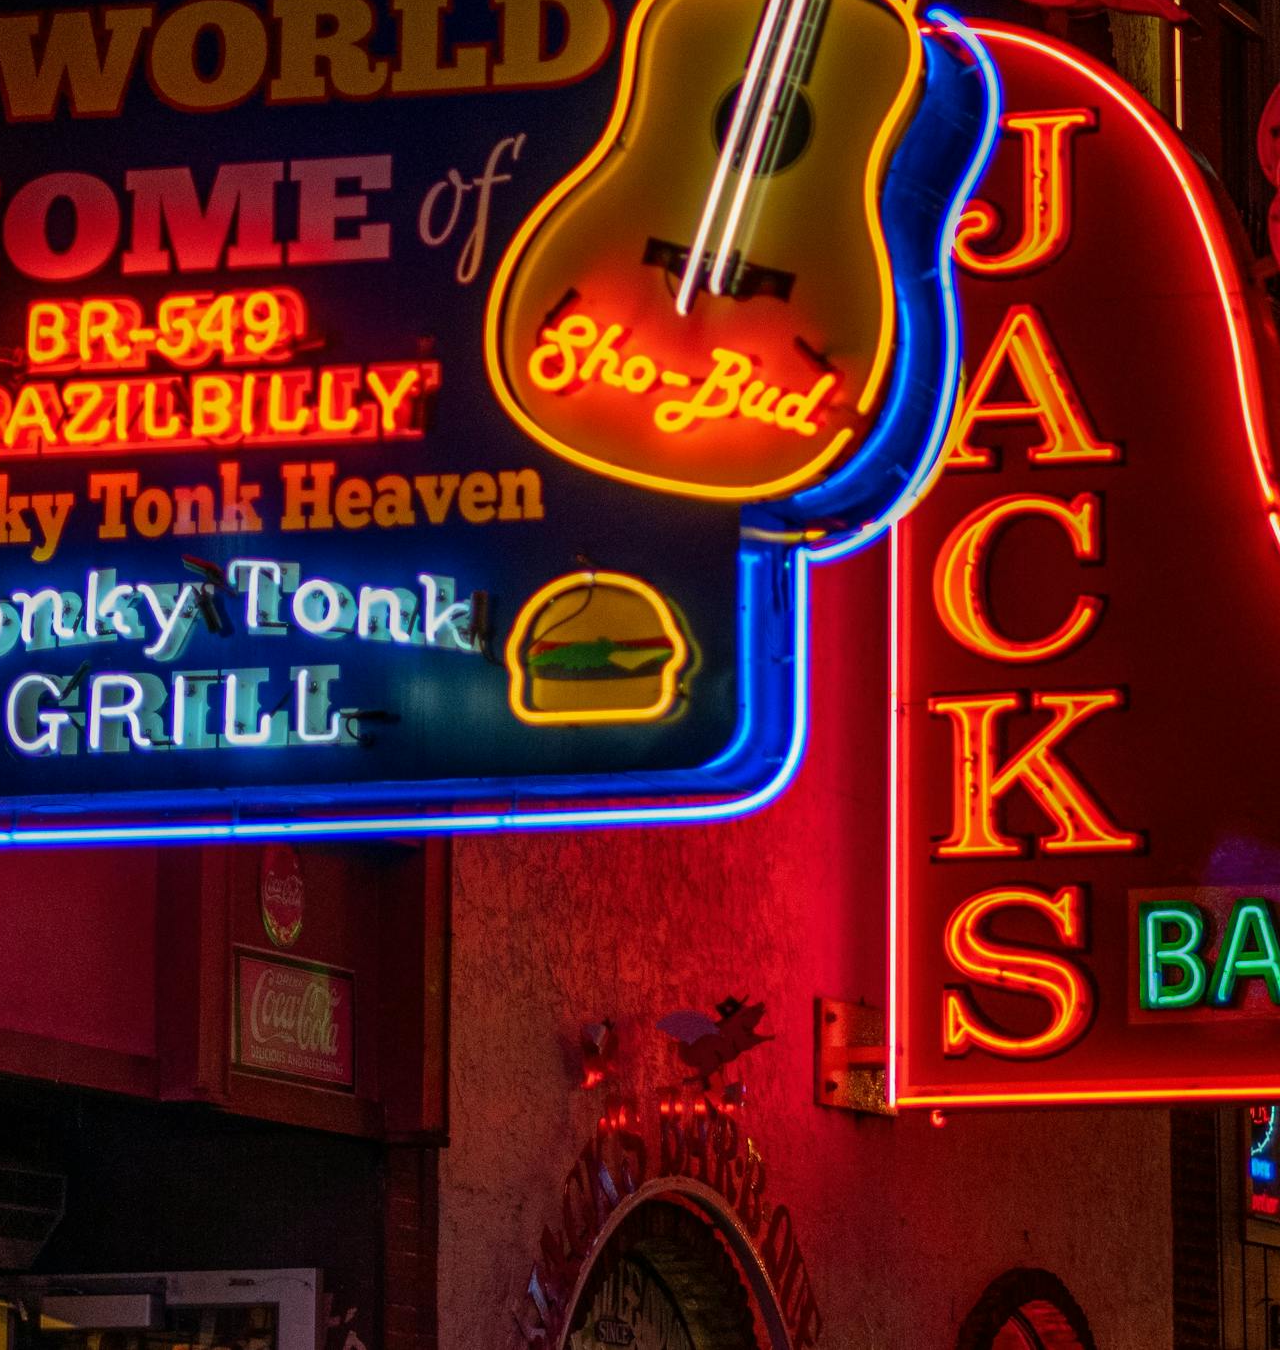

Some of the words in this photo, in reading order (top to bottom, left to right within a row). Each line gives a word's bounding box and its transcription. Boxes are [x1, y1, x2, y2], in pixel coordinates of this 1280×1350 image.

[419, 133, 524, 284] of
[23, 284, 308, 374] BR-549
[527, 312, 841, 440] Sho-Bud
[91, 461, 265, 540] Tonk
[280, 467, 545, 532] Heaven
[228, 557, 486, 656] Tonk
[930, 105, 1148, 1057] JACKS
[5, 663, 364, 759] GRILL
[250, 968, 342, 1057] Coca-Cola
